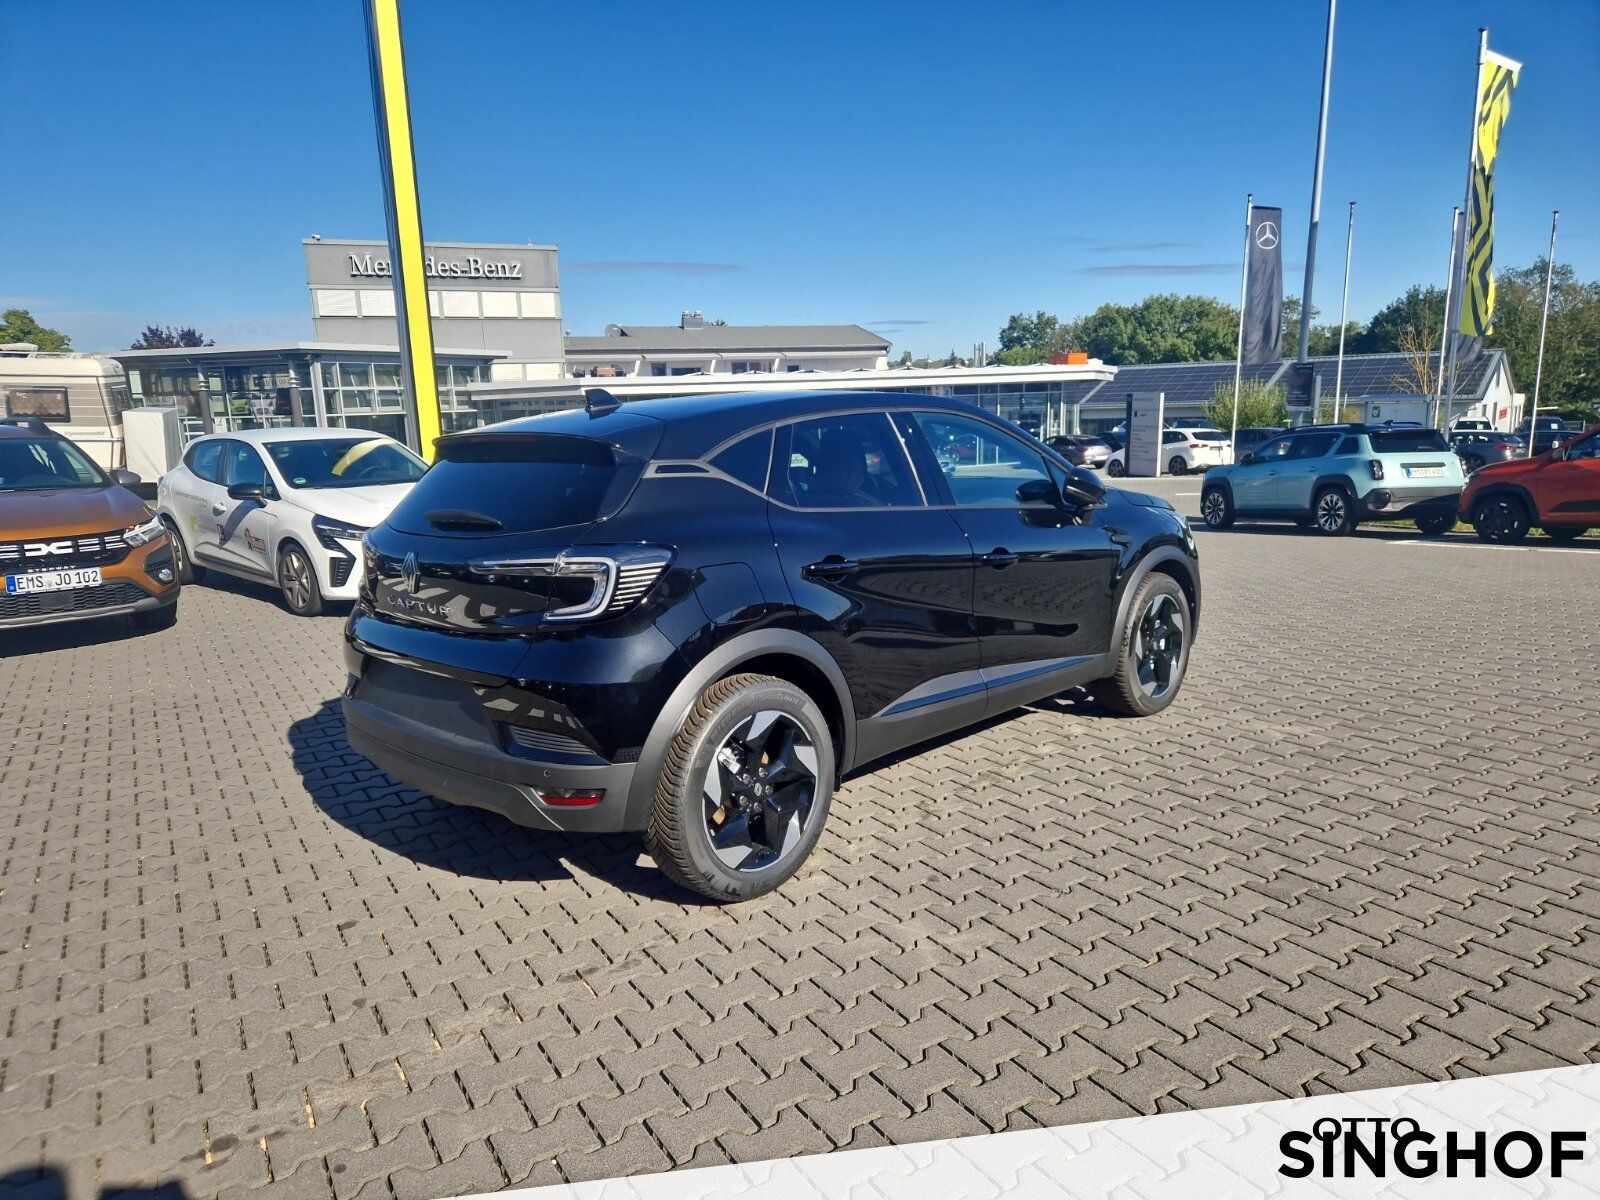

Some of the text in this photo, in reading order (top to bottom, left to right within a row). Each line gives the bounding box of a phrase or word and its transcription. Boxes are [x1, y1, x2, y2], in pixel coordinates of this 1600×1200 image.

[17, 570, 99, 590] EMS JO 102
[386, 595, 450, 616] CAPTUR
